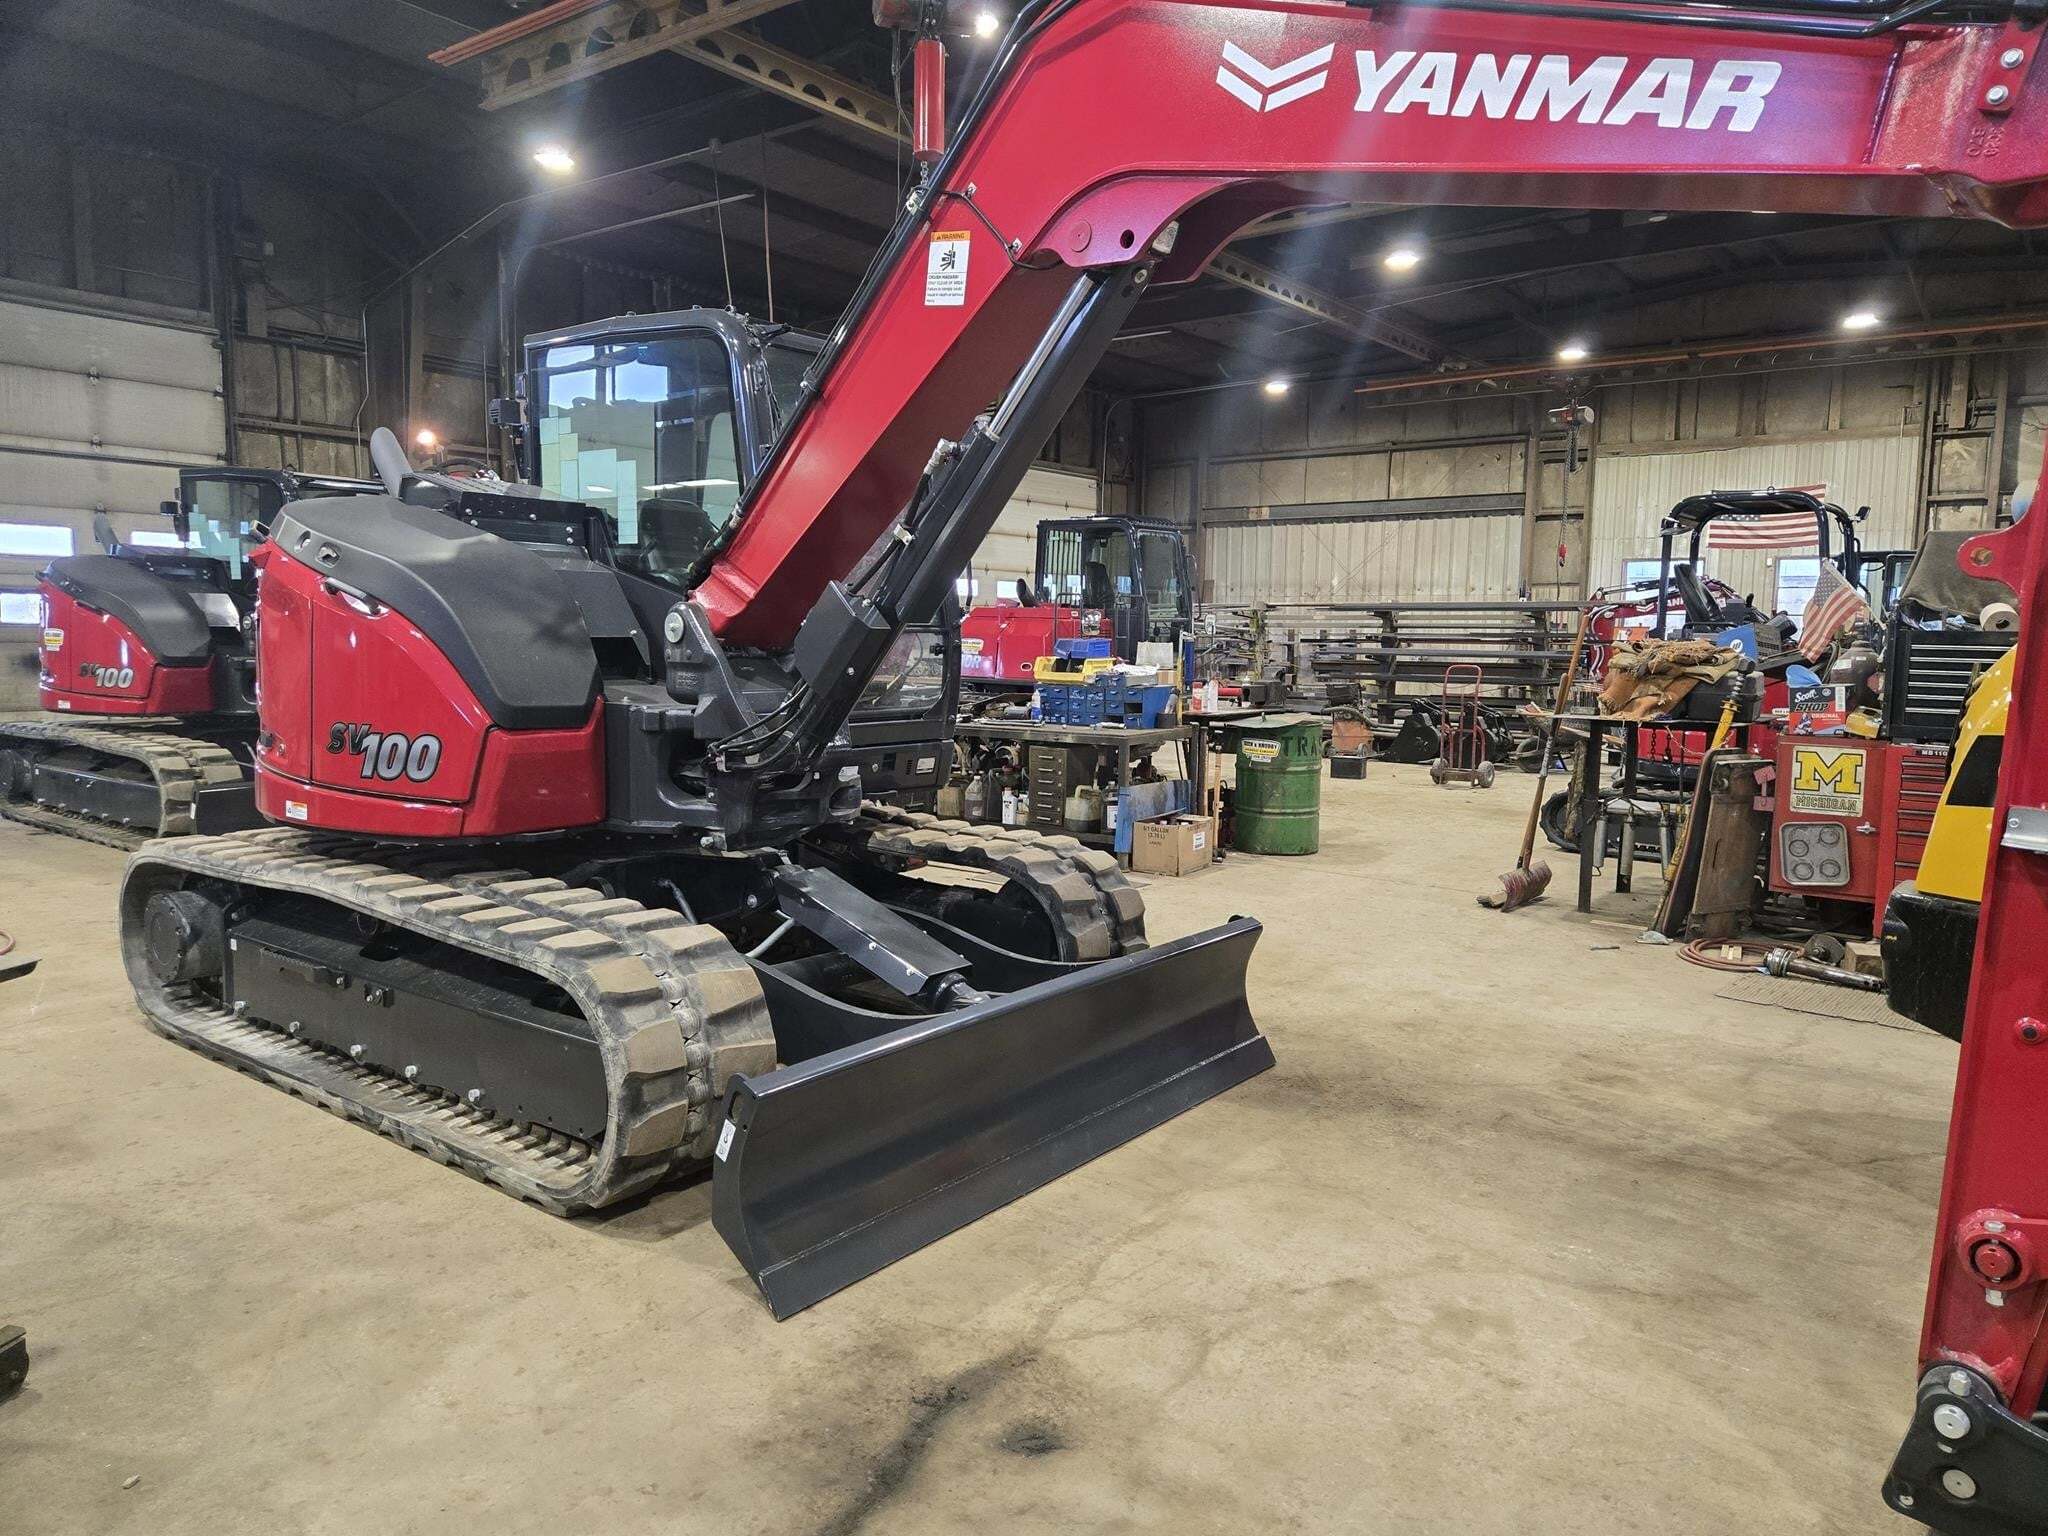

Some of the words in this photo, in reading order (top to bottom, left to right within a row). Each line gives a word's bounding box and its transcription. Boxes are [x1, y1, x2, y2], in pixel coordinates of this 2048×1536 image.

[1353, 50, 1783, 132] YANMAR
[1794, 702, 1830, 713] SHOP
[1794, 751, 1863, 795] M
[1795, 795, 1857, 811] MICHIGAN
